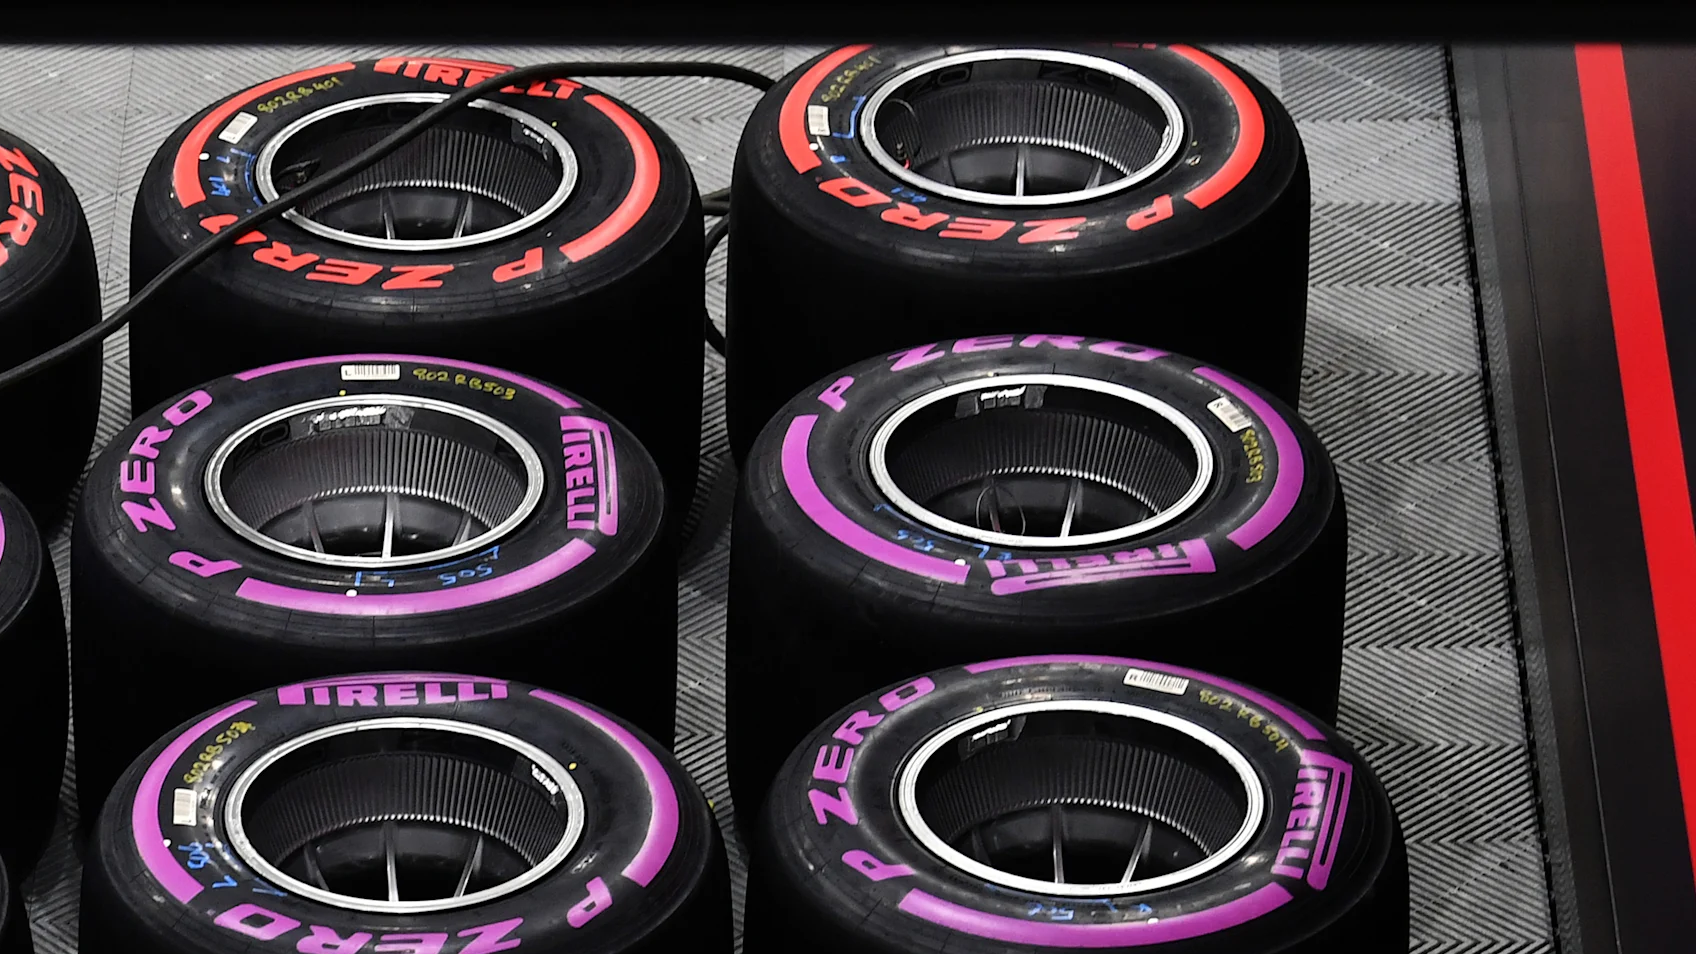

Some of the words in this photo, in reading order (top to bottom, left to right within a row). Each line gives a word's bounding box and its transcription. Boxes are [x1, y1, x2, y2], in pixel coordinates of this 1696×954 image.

[818, 176, 1087, 244] ZERO
[1127, 193, 1175, 231] P
[492, 247, 544, 284] P
[817, 375, 855, 412] P
[887, 334, 1171, 370] ZERO
[121, 389, 213, 533] ZERO
[559, 415, 619, 537] PIRELLI
[169, 550, 242, 578] P
[987, 538, 1217, 595] PIRELLI
[276, 671, 511, 707] PIRELLI
[807, 675, 936, 826] ZERO
[1270, 749, 1354, 891] PIRELLI
[841, 849, 916, 882] P
[566, 876, 613, 929] P
